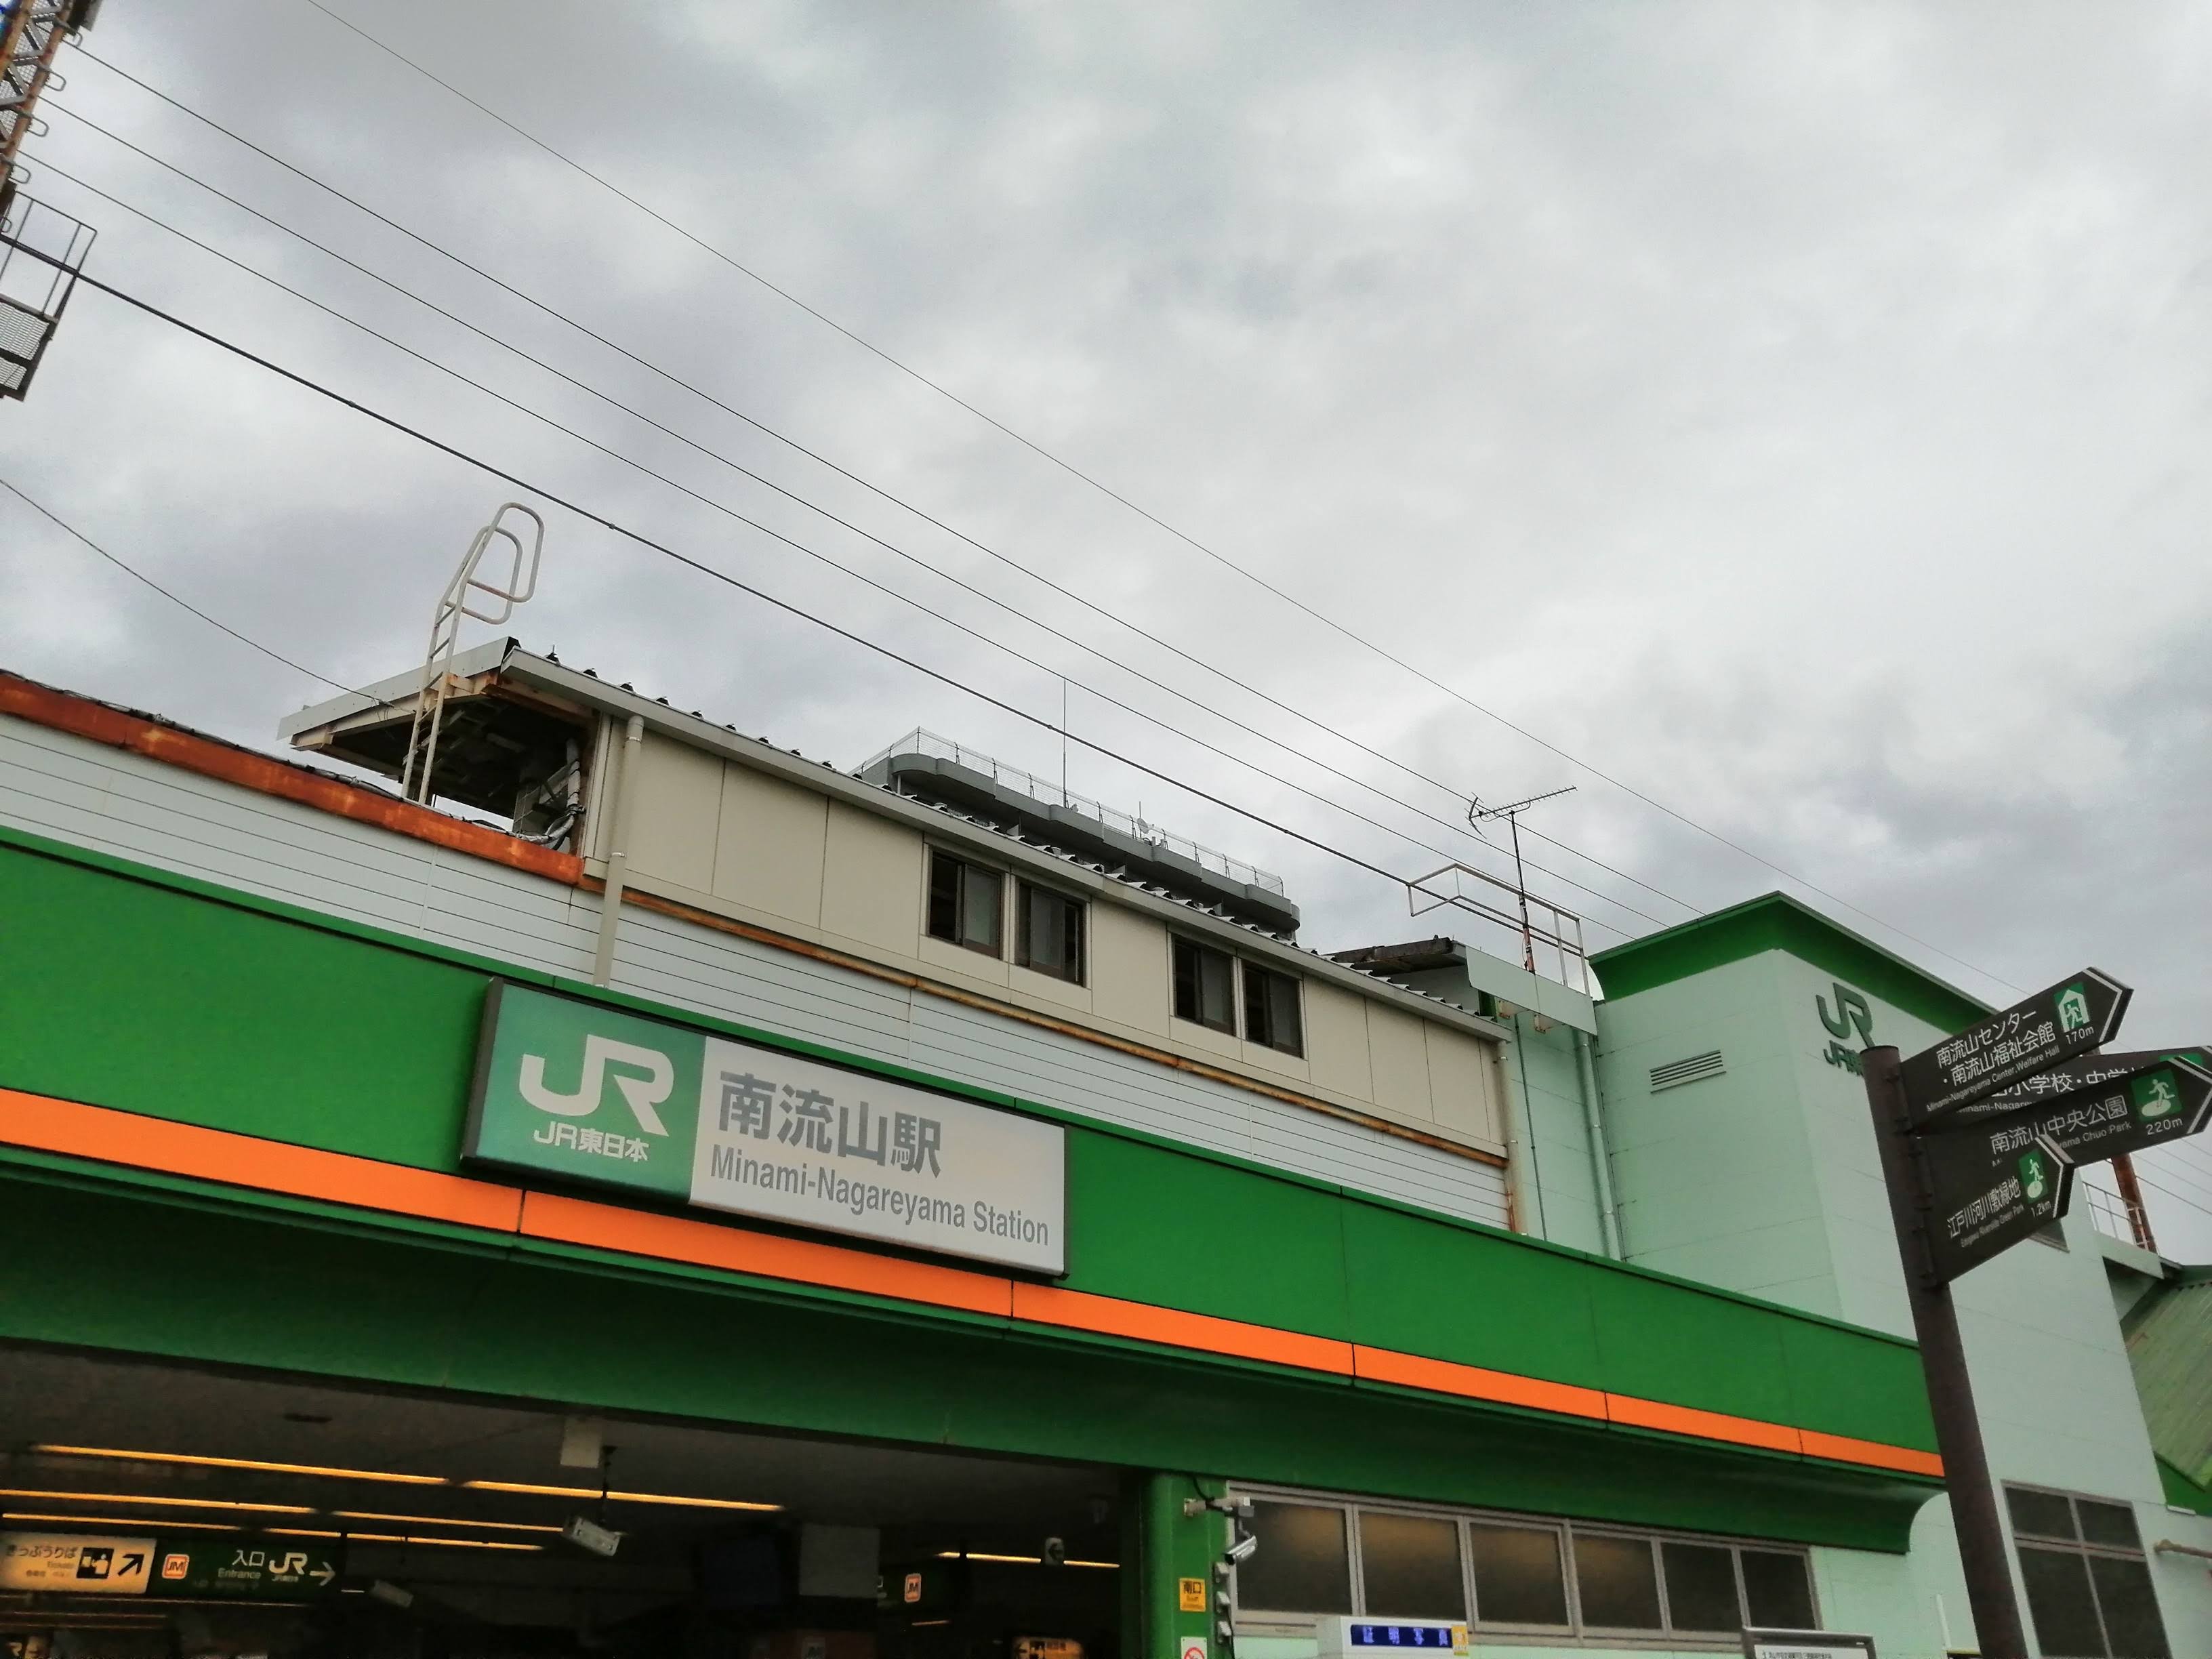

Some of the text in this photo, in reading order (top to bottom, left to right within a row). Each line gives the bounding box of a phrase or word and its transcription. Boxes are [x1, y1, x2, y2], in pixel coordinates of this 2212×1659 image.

[1816, 982, 1876, 1048] JR
[1936, 1010, 2037, 1069] 南流山センター
[2065, 1025, 2095, 1045] 170m
[518, 1034, 675, 1137] JR
[1926, 1078, 1991, 1111] Minami-Nagareyama
[2045, 1044, 2061, 1058] Hall
[533, 1120, 651, 1164] JR東日本
[716, 1071, 943, 1180] 南流山駅
[1990, 1094, 2129, 1155] 南流山中央公園
[2082, 1129, 2107, 1143] Chuo
[2108, 1120, 2133, 1134] Park
[2145, 1118, 2184, 1136] 220m
[710, 1143, 1051, 1247] Minami-Nagareyama Station
[218, 1567, 262, 1580] Entrance
[232, 1549, 266, 1568] 入口
[268, 1551, 308, 1576] JR
